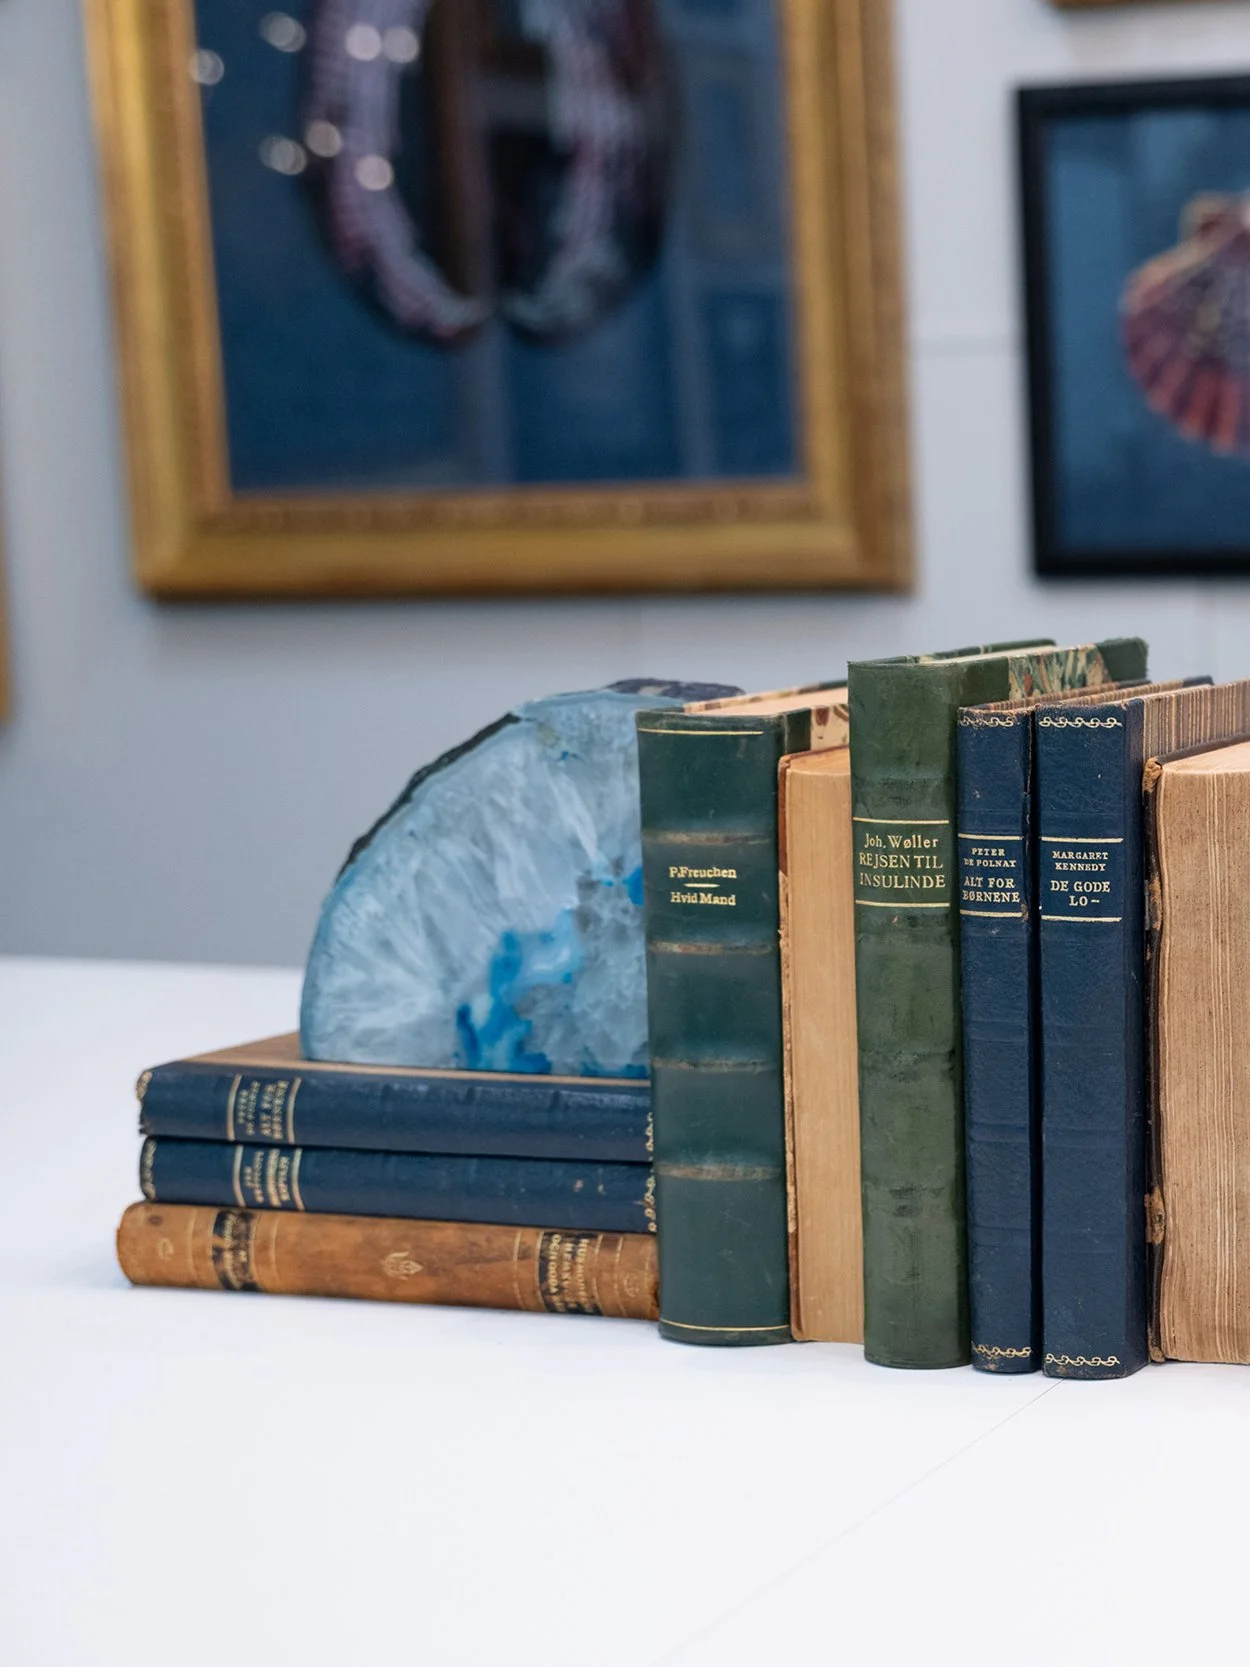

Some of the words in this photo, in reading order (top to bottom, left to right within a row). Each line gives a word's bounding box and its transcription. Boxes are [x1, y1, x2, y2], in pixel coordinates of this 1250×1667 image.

[864, 833, 887, 849] Joh.
[887, 834, 939, 849] Wøller
[971, 847, 1005, 857] PETER
[1052, 850, 1109, 860] MARGARET
[859, 852, 911, 869] REJSEN
[913, 855, 944, 869] TIL
[963, 858, 974, 866] DE
[976, 859, 1017, 868] POLNAY
[1055, 862, 1106, 872] KENNEDY
[860, 872, 946, 889] INSULINDE
[963, 876, 984, 888] ALT
[987, 877, 1015, 889] FOR
[1050, 880, 1069, 892] DE
[1073, 880, 1111, 893] GODE
[670, 892, 698, 904] Hvid
[699, 893, 737, 906] Mand
[962, 889, 1021, 903] BØRNENE
